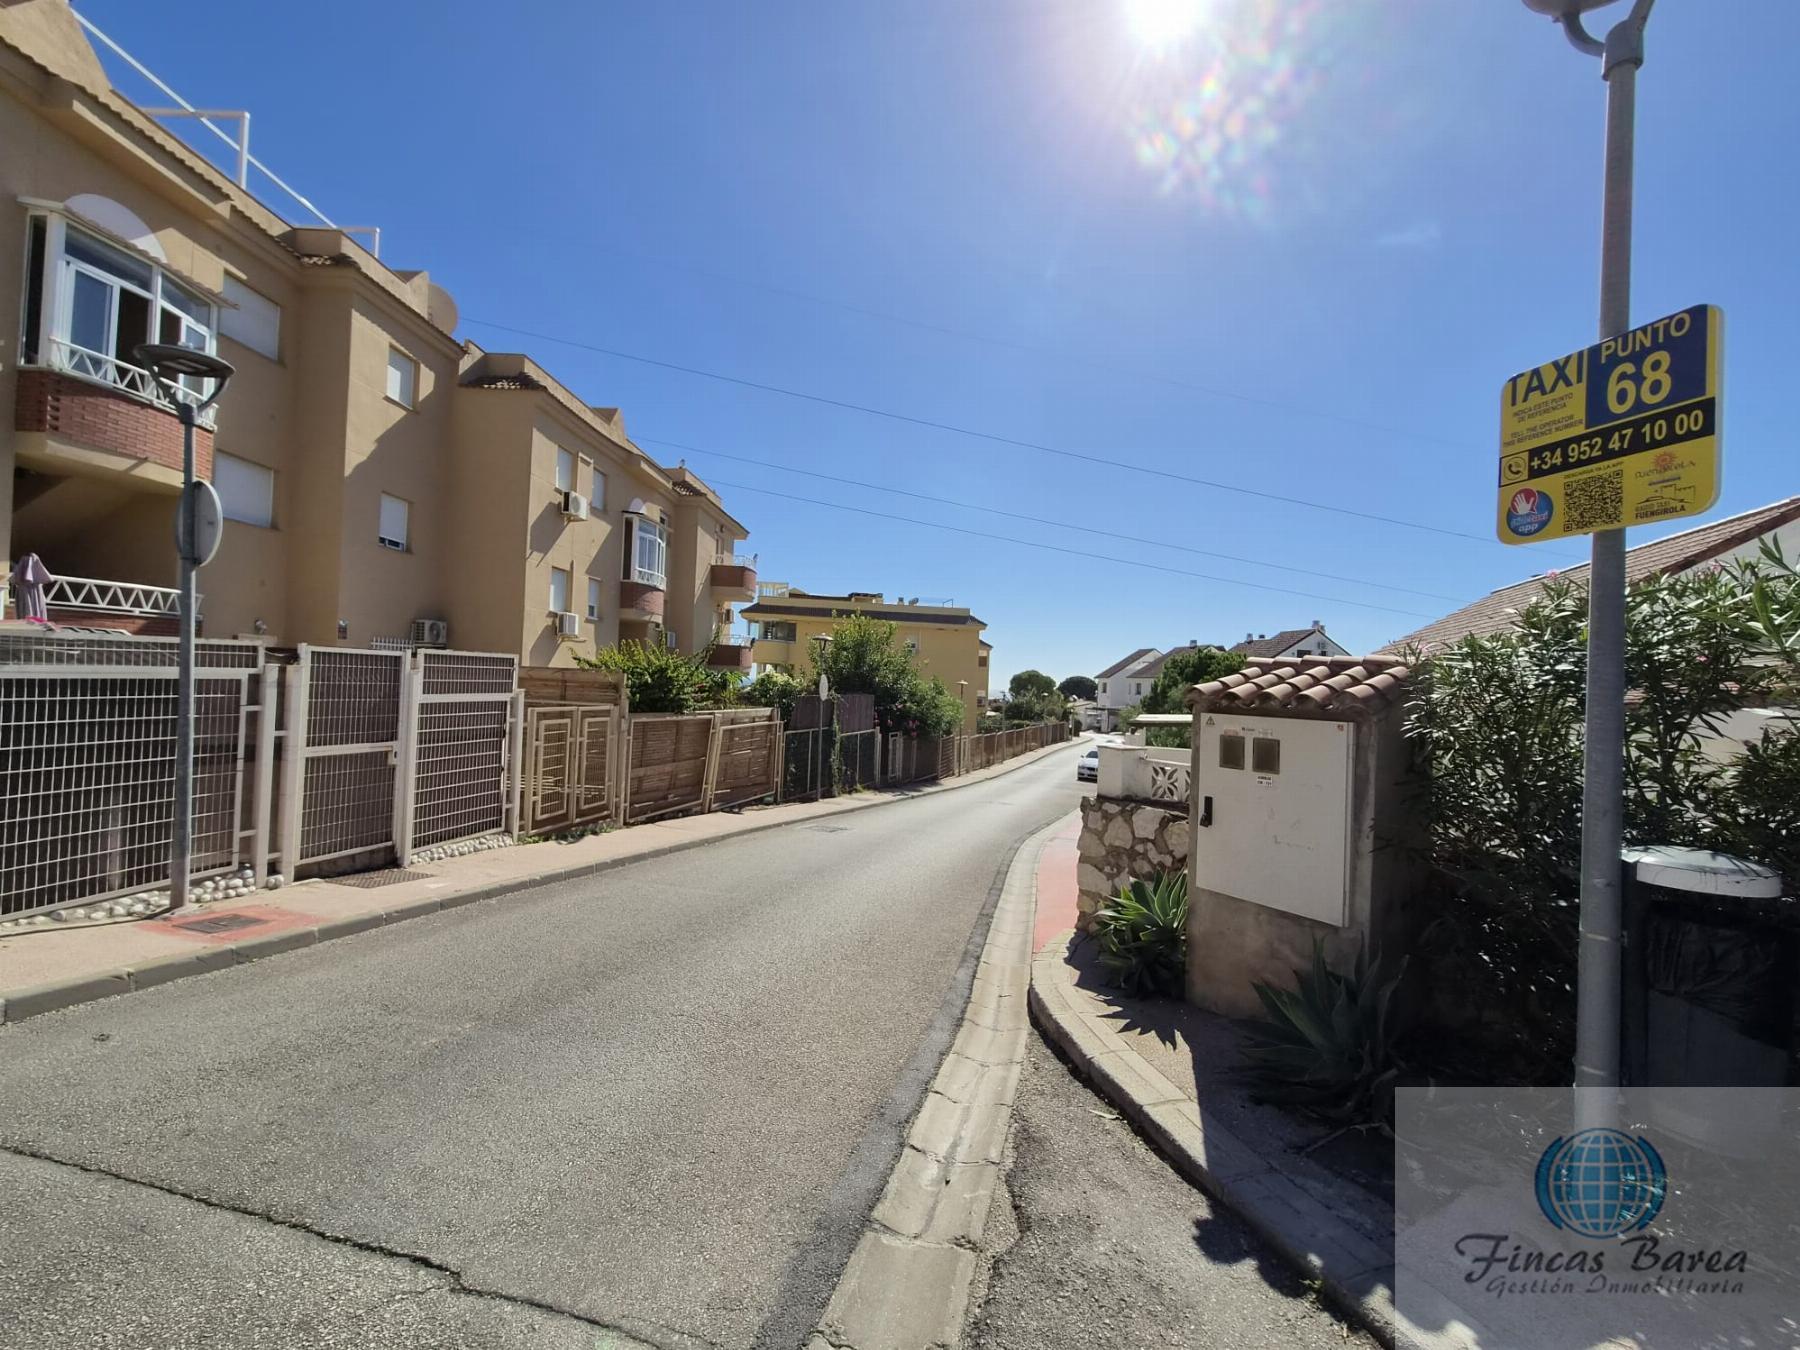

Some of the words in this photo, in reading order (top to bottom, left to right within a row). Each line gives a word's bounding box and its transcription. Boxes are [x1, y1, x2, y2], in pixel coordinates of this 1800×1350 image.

[1601, 312, 1691, 364] PUNTO
[1507, 350, 1584, 407] TAXI
[1551, 392, 1573, 406] PUNTO
[1607, 350, 1672, 414] 68
[1531, 448, 1563, 470] +34
[1568, 437, 1603, 463] 952
[1608, 428, 1634, 451] 47
[1641, 419, 1667, 443] 10
[1674, 409, 1704, 434] 00
[1519, 523, 1538, 534] app
[1635, 504, 1686, 519] FUENGIROLA
